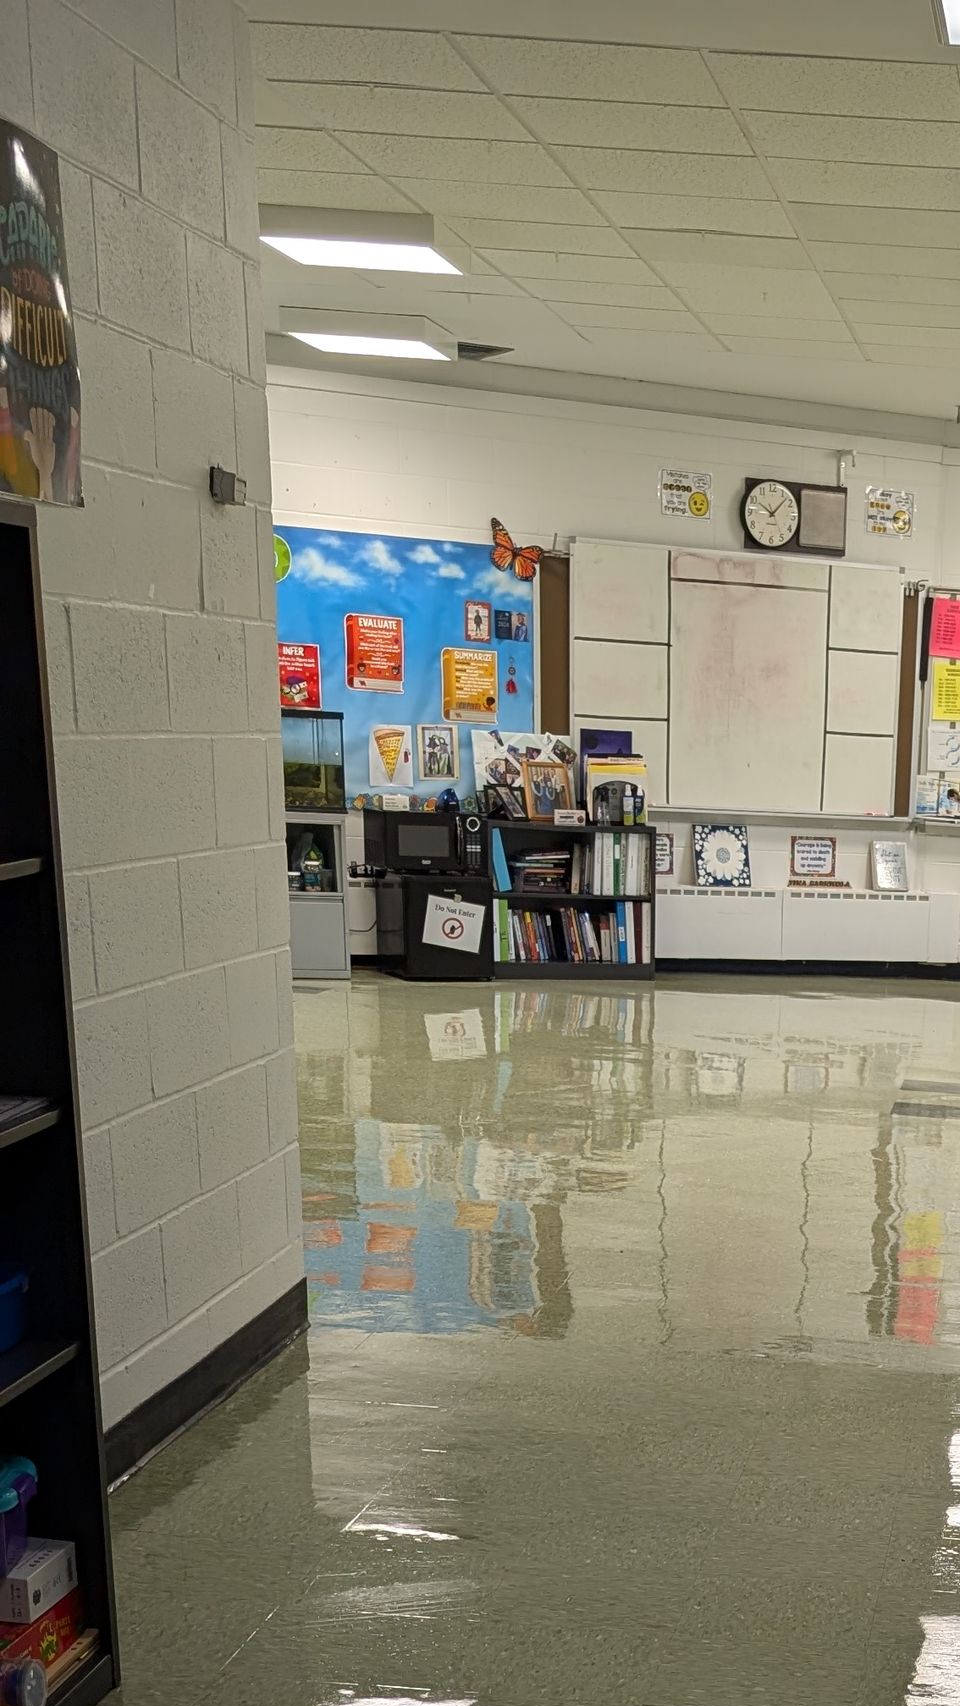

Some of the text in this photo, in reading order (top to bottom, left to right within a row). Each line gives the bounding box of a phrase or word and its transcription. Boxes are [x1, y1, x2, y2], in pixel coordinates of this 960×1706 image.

[0, 286, 67, 368] DIFFICULT
[760, 487, 766, 496] 11
[769, 484, 777, 492] 12
[750, 495, 758, 504] 10
[788, 499, 793, 508] 2
[790, 511, 796, 521] 3
[750, 520, 756, 530] 8
[787, 524, 792, 533] 4
[759, 531, 764, 540] 7
[769, 536, 774, 544] 6
[779, 534, 784, 542] 5
[358, 617, 398, 630] EVALUATE
[282, 646, 304, 656] INFER
[454, 651, 492, 662] SUMMARIZE
[446, 906, 457, 914] Not
[458, 909, 476, 918] Enter
